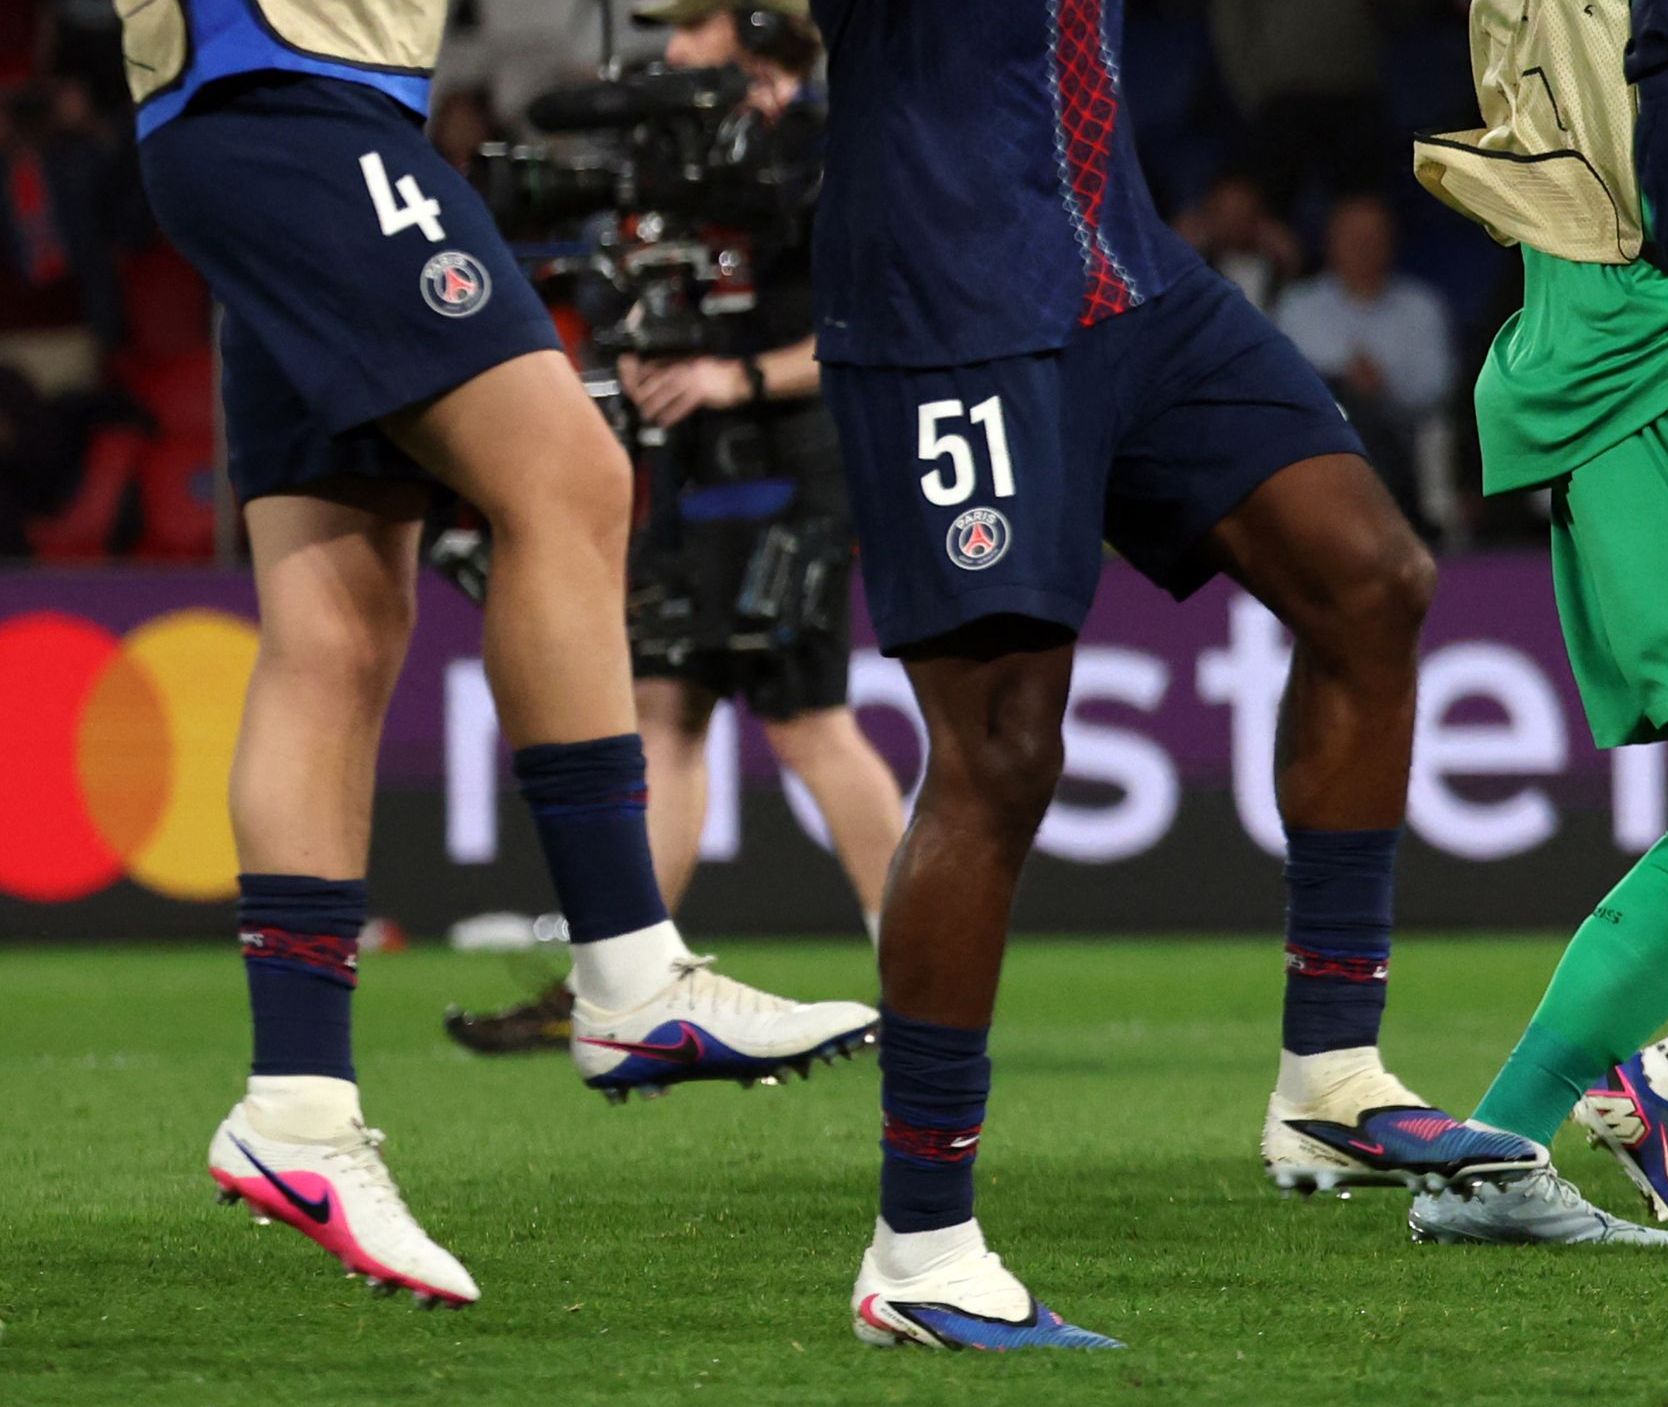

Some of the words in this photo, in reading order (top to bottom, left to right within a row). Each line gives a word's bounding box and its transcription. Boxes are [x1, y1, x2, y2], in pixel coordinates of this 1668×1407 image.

[358, 150, 447, 243] 4
[918, 395, 1016, 507] 51
[955, 510, 998, 530] PARIS
